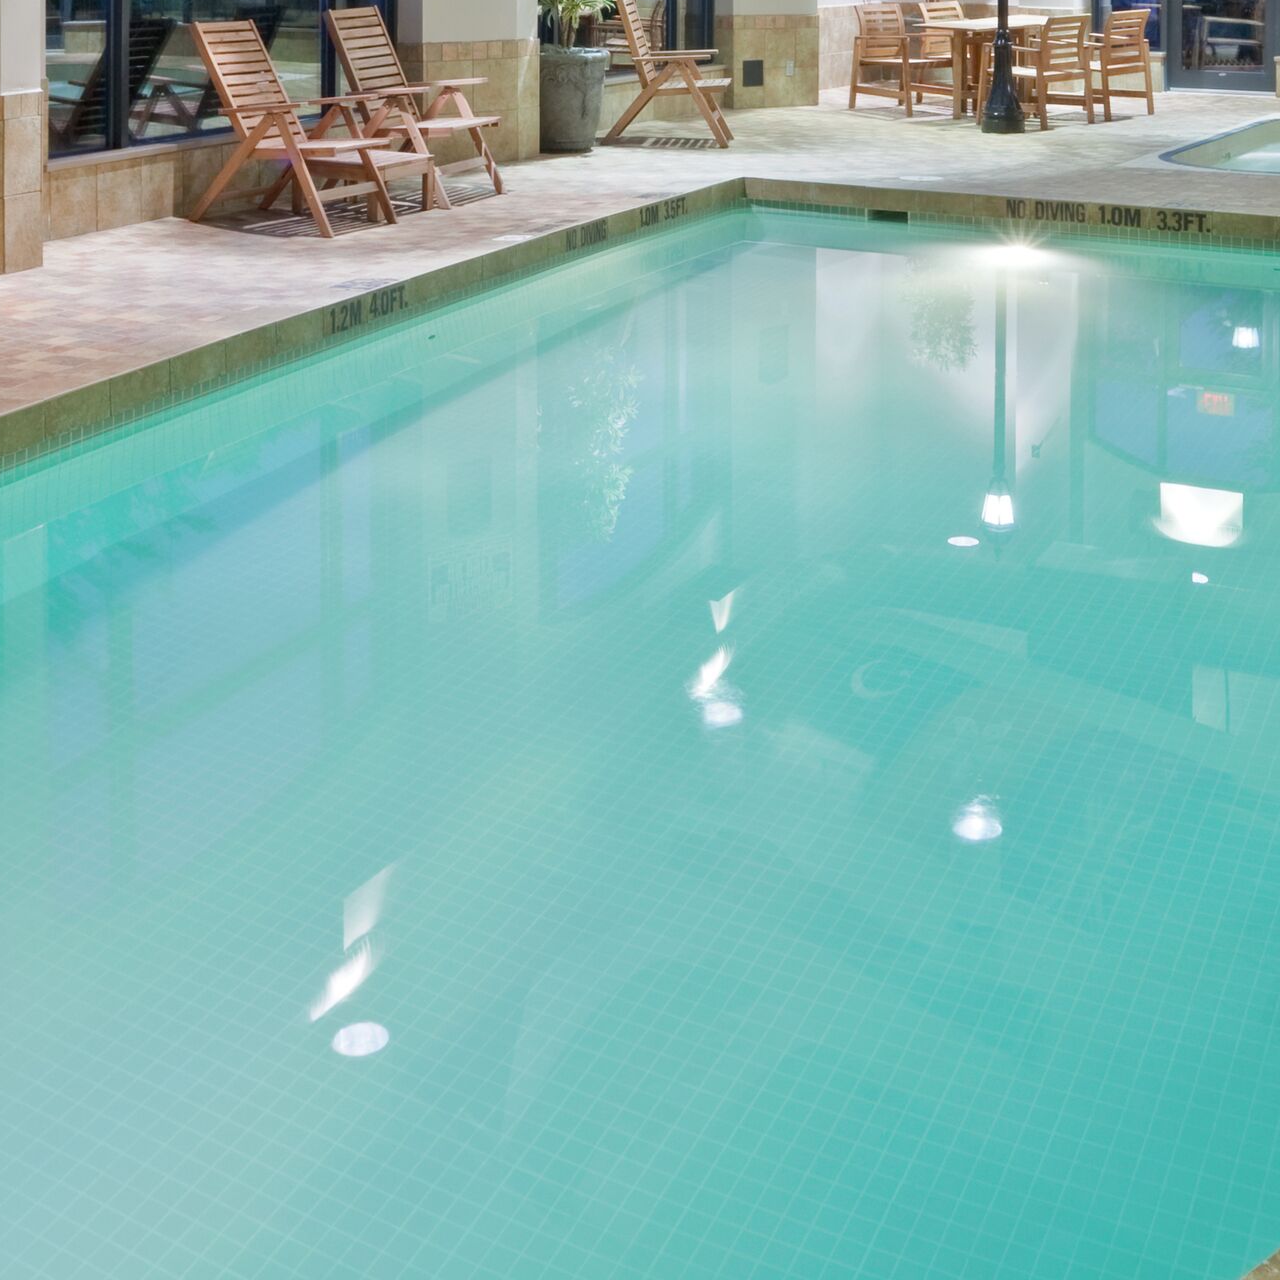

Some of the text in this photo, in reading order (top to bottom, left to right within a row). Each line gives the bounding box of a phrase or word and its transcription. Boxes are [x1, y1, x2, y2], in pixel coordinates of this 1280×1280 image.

[1006, 199, 1211, 233] NO DIVING 1.0M 3.3FT.
[565, 229, 577, 252] NO
[580, 219, 608, 247] DIVING
[330, 285, 408, 334] 1.2M 4.0FT.
